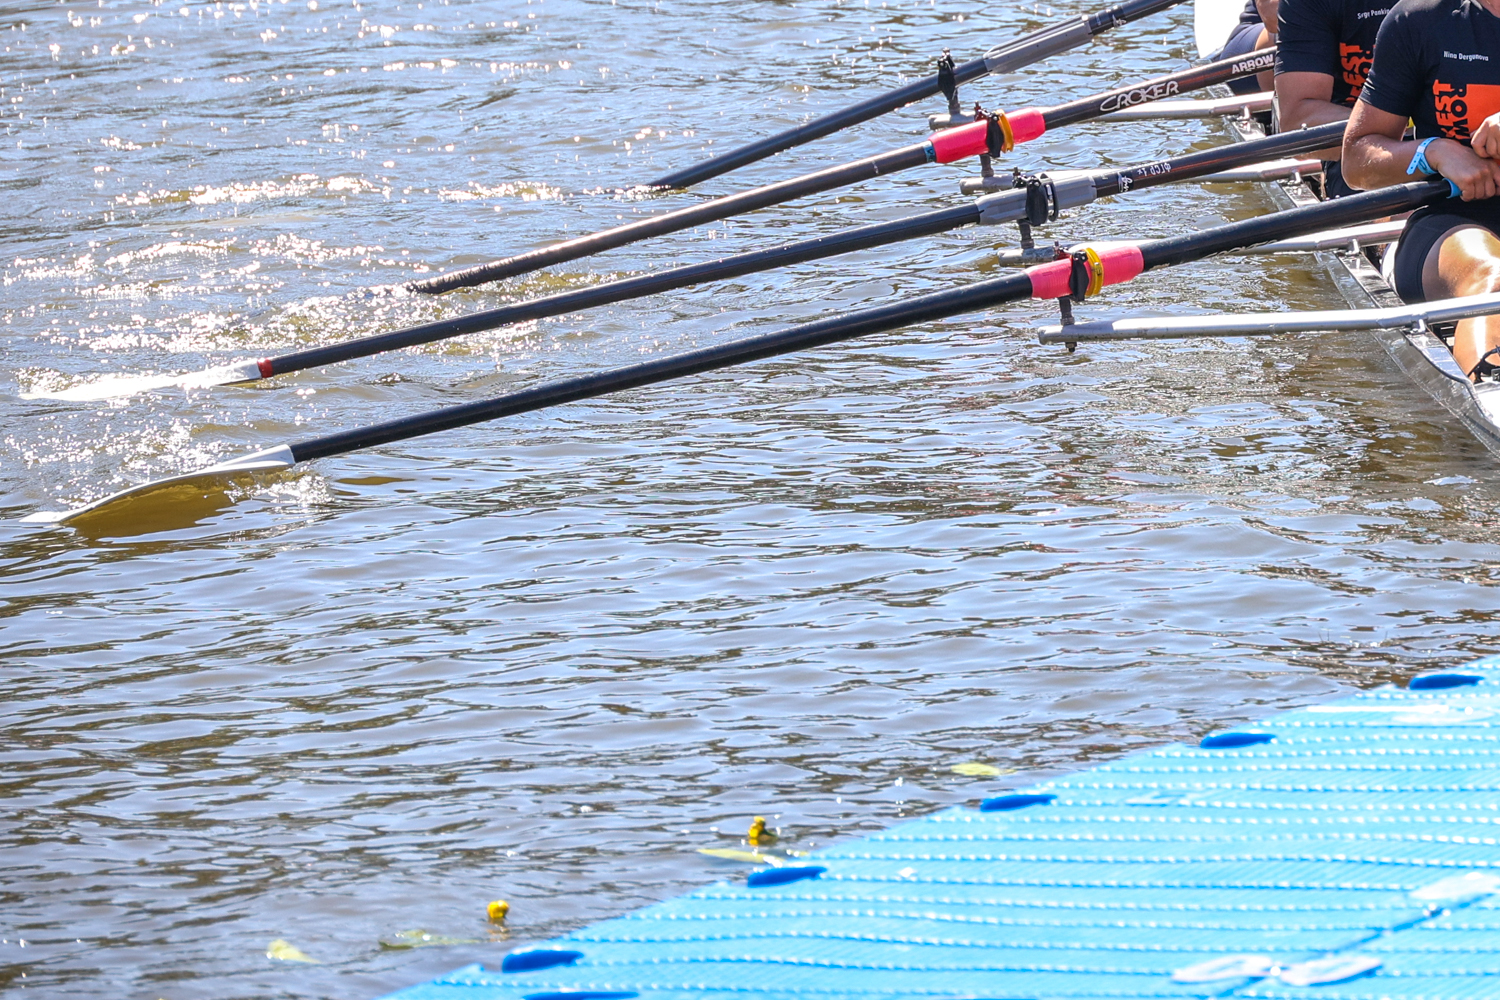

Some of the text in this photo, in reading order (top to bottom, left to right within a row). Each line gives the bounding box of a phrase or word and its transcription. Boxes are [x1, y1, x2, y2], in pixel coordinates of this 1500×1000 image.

[1231, 53, 1275, 74] ARROW
[1443, 50, 1457, 59] Nina
[1100, 81, 1179, 112] CROKER
